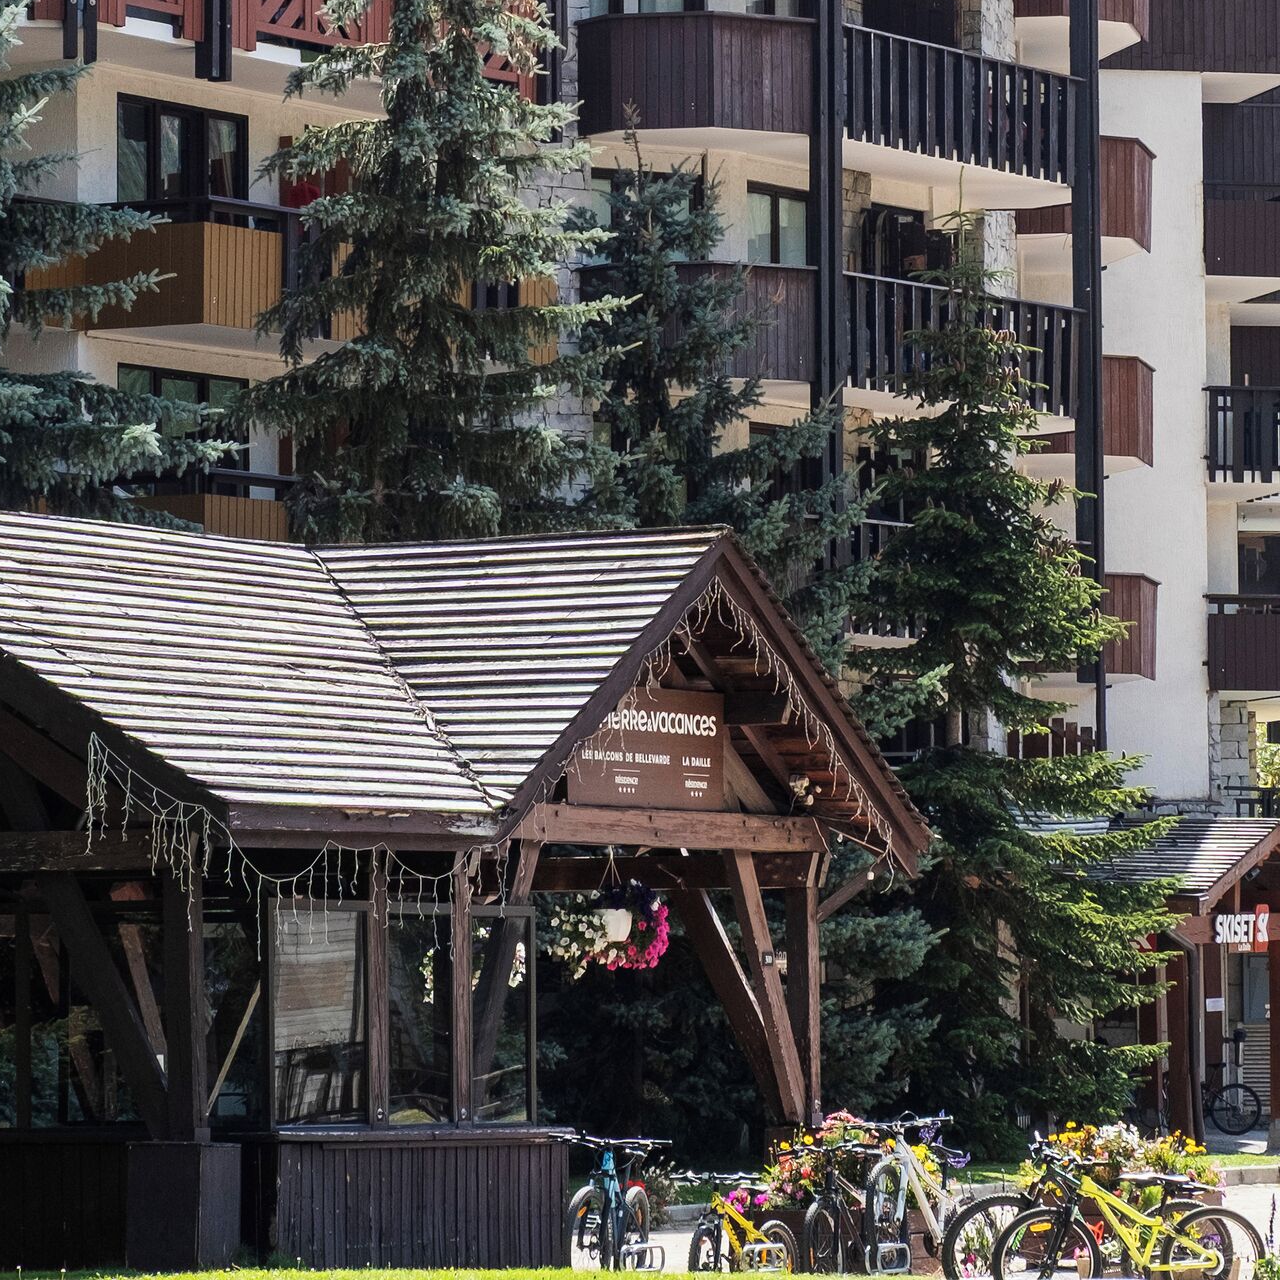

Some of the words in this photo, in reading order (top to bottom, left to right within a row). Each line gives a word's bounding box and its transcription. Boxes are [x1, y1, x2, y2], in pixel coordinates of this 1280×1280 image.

[582, 749, 593, 760] LES
[594, 750, 623, 762] BALCONS
[625, 752, 634, 763] DE
[635, 753, 671, 765] BELLEVARDE
[682, 756, 690, 766] LA
[691, 757, 711, 768] DAILLE
[1215, 914, 1256, 944] SKISET
